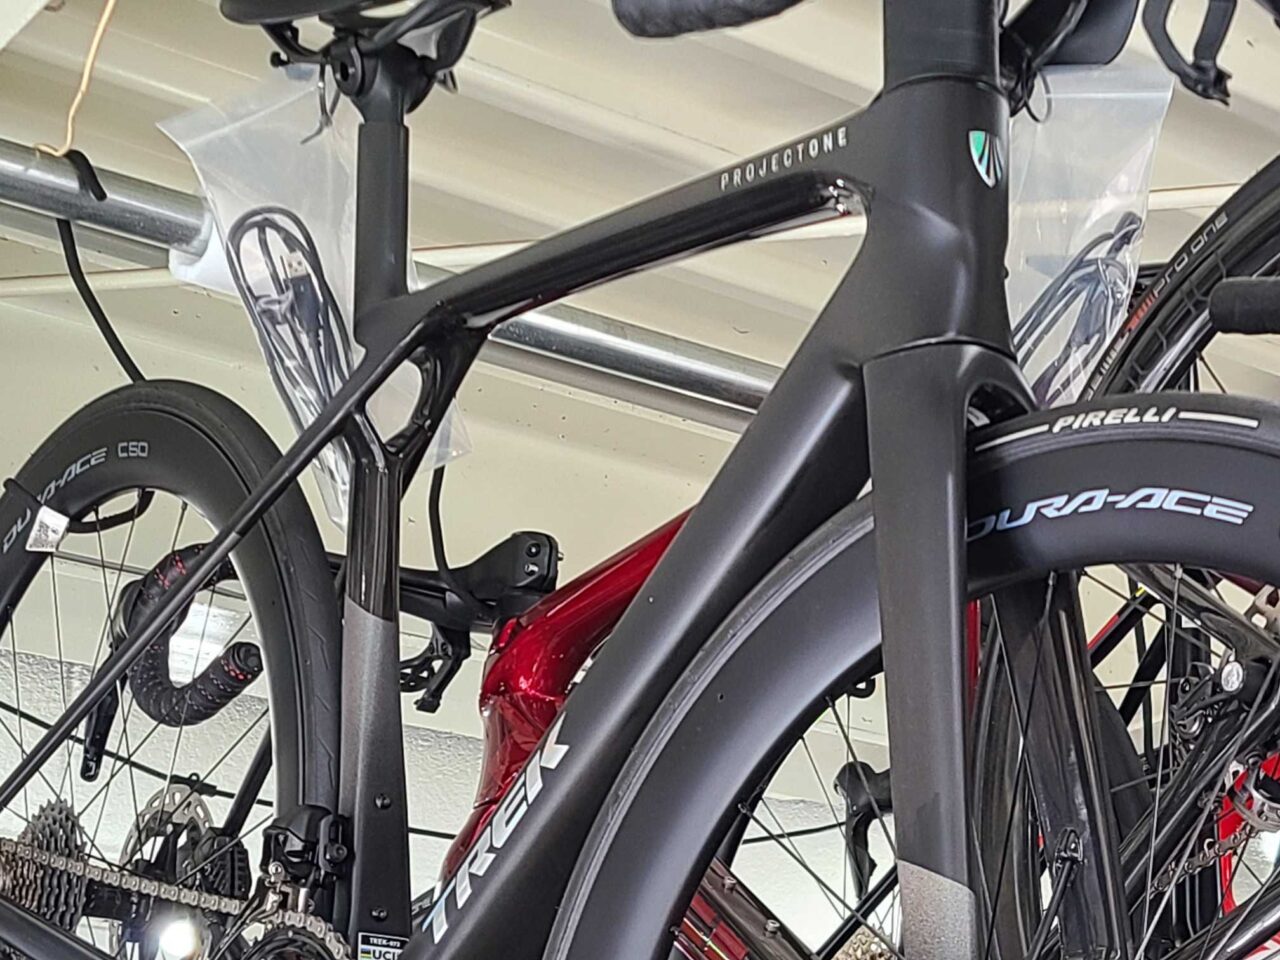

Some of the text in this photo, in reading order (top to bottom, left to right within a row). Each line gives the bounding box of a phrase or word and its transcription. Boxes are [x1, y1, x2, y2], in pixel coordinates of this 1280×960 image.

[1052, 406, 1177, 434] PIRELLI
[3, 441, 149, 553] DUA-ACE C50
[421, 710, 571, 946] TREK
